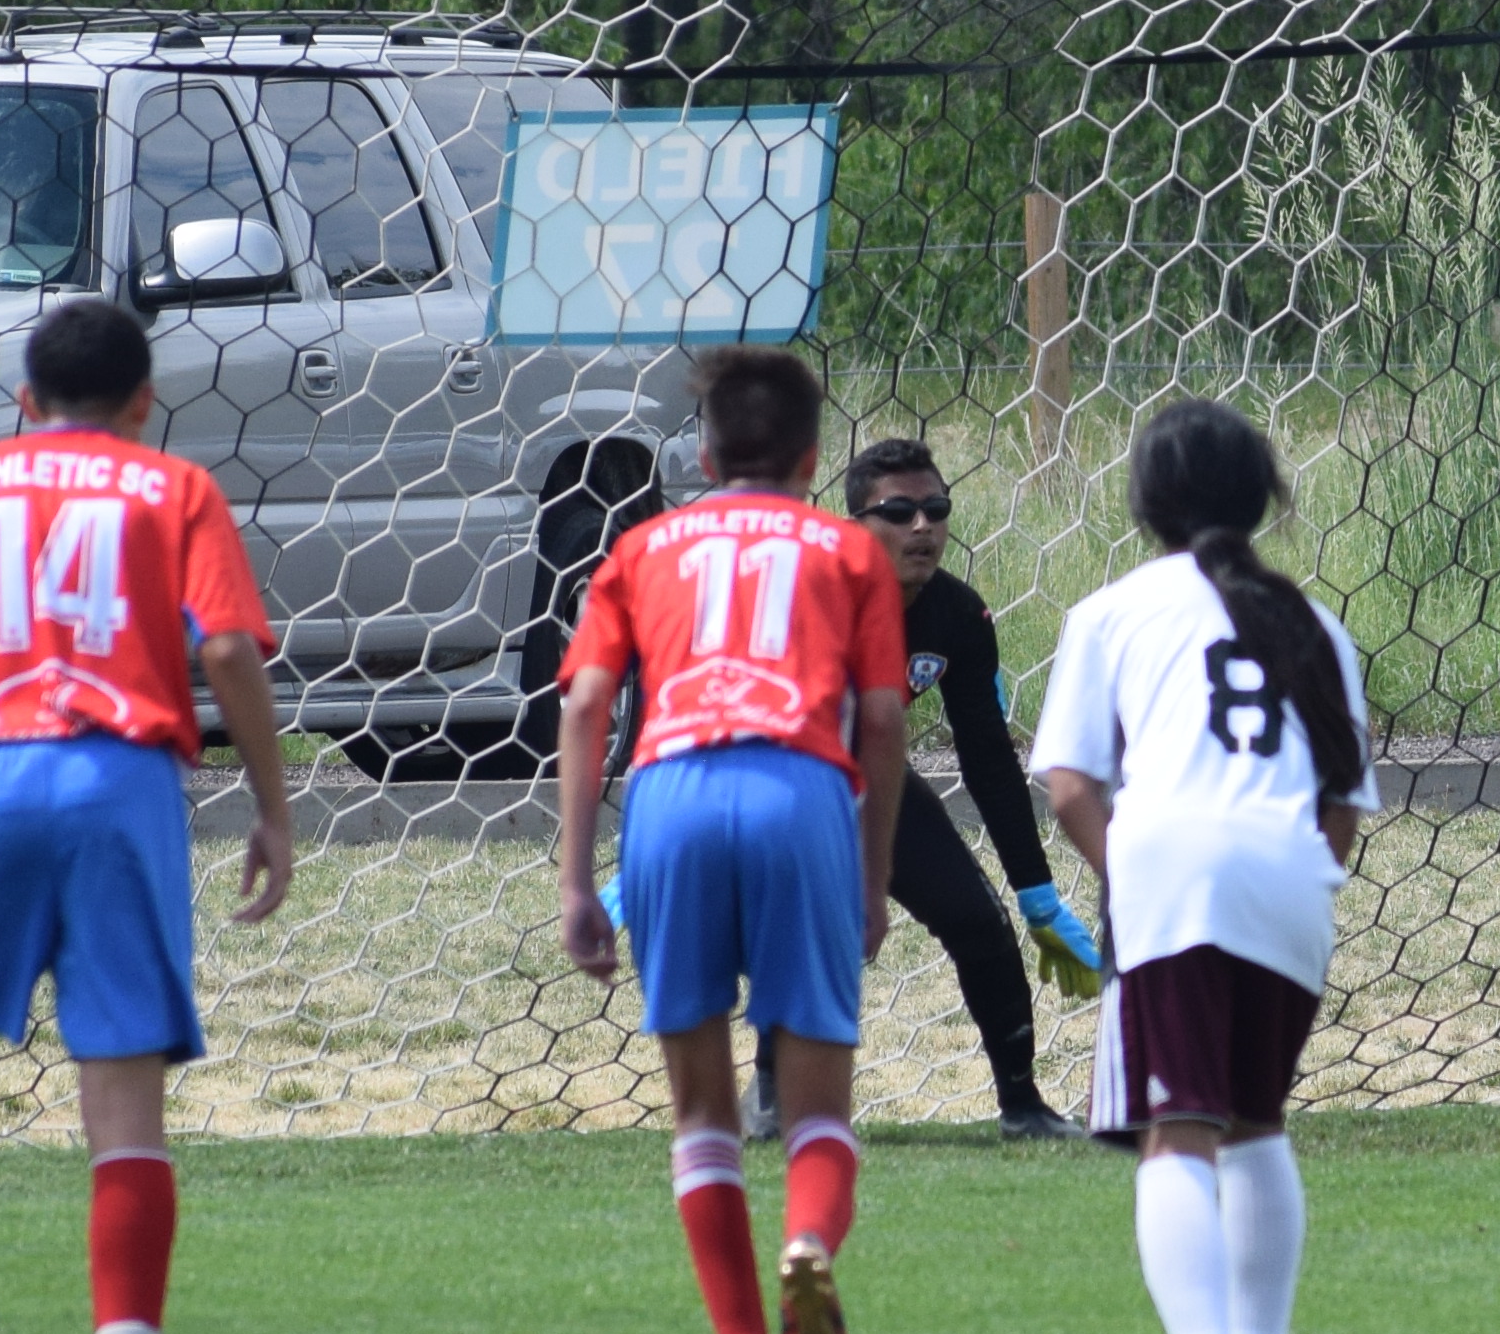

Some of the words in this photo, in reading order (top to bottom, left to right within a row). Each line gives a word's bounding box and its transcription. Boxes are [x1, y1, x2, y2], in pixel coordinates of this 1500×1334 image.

[118, 462, 167, 506] SC
[646, 508, 794, 554] ATHLETIC
[799, 518, 842, 554] SC
[678, 536, 801, 661] 11
[1204, 638, 1281, 758] 8
